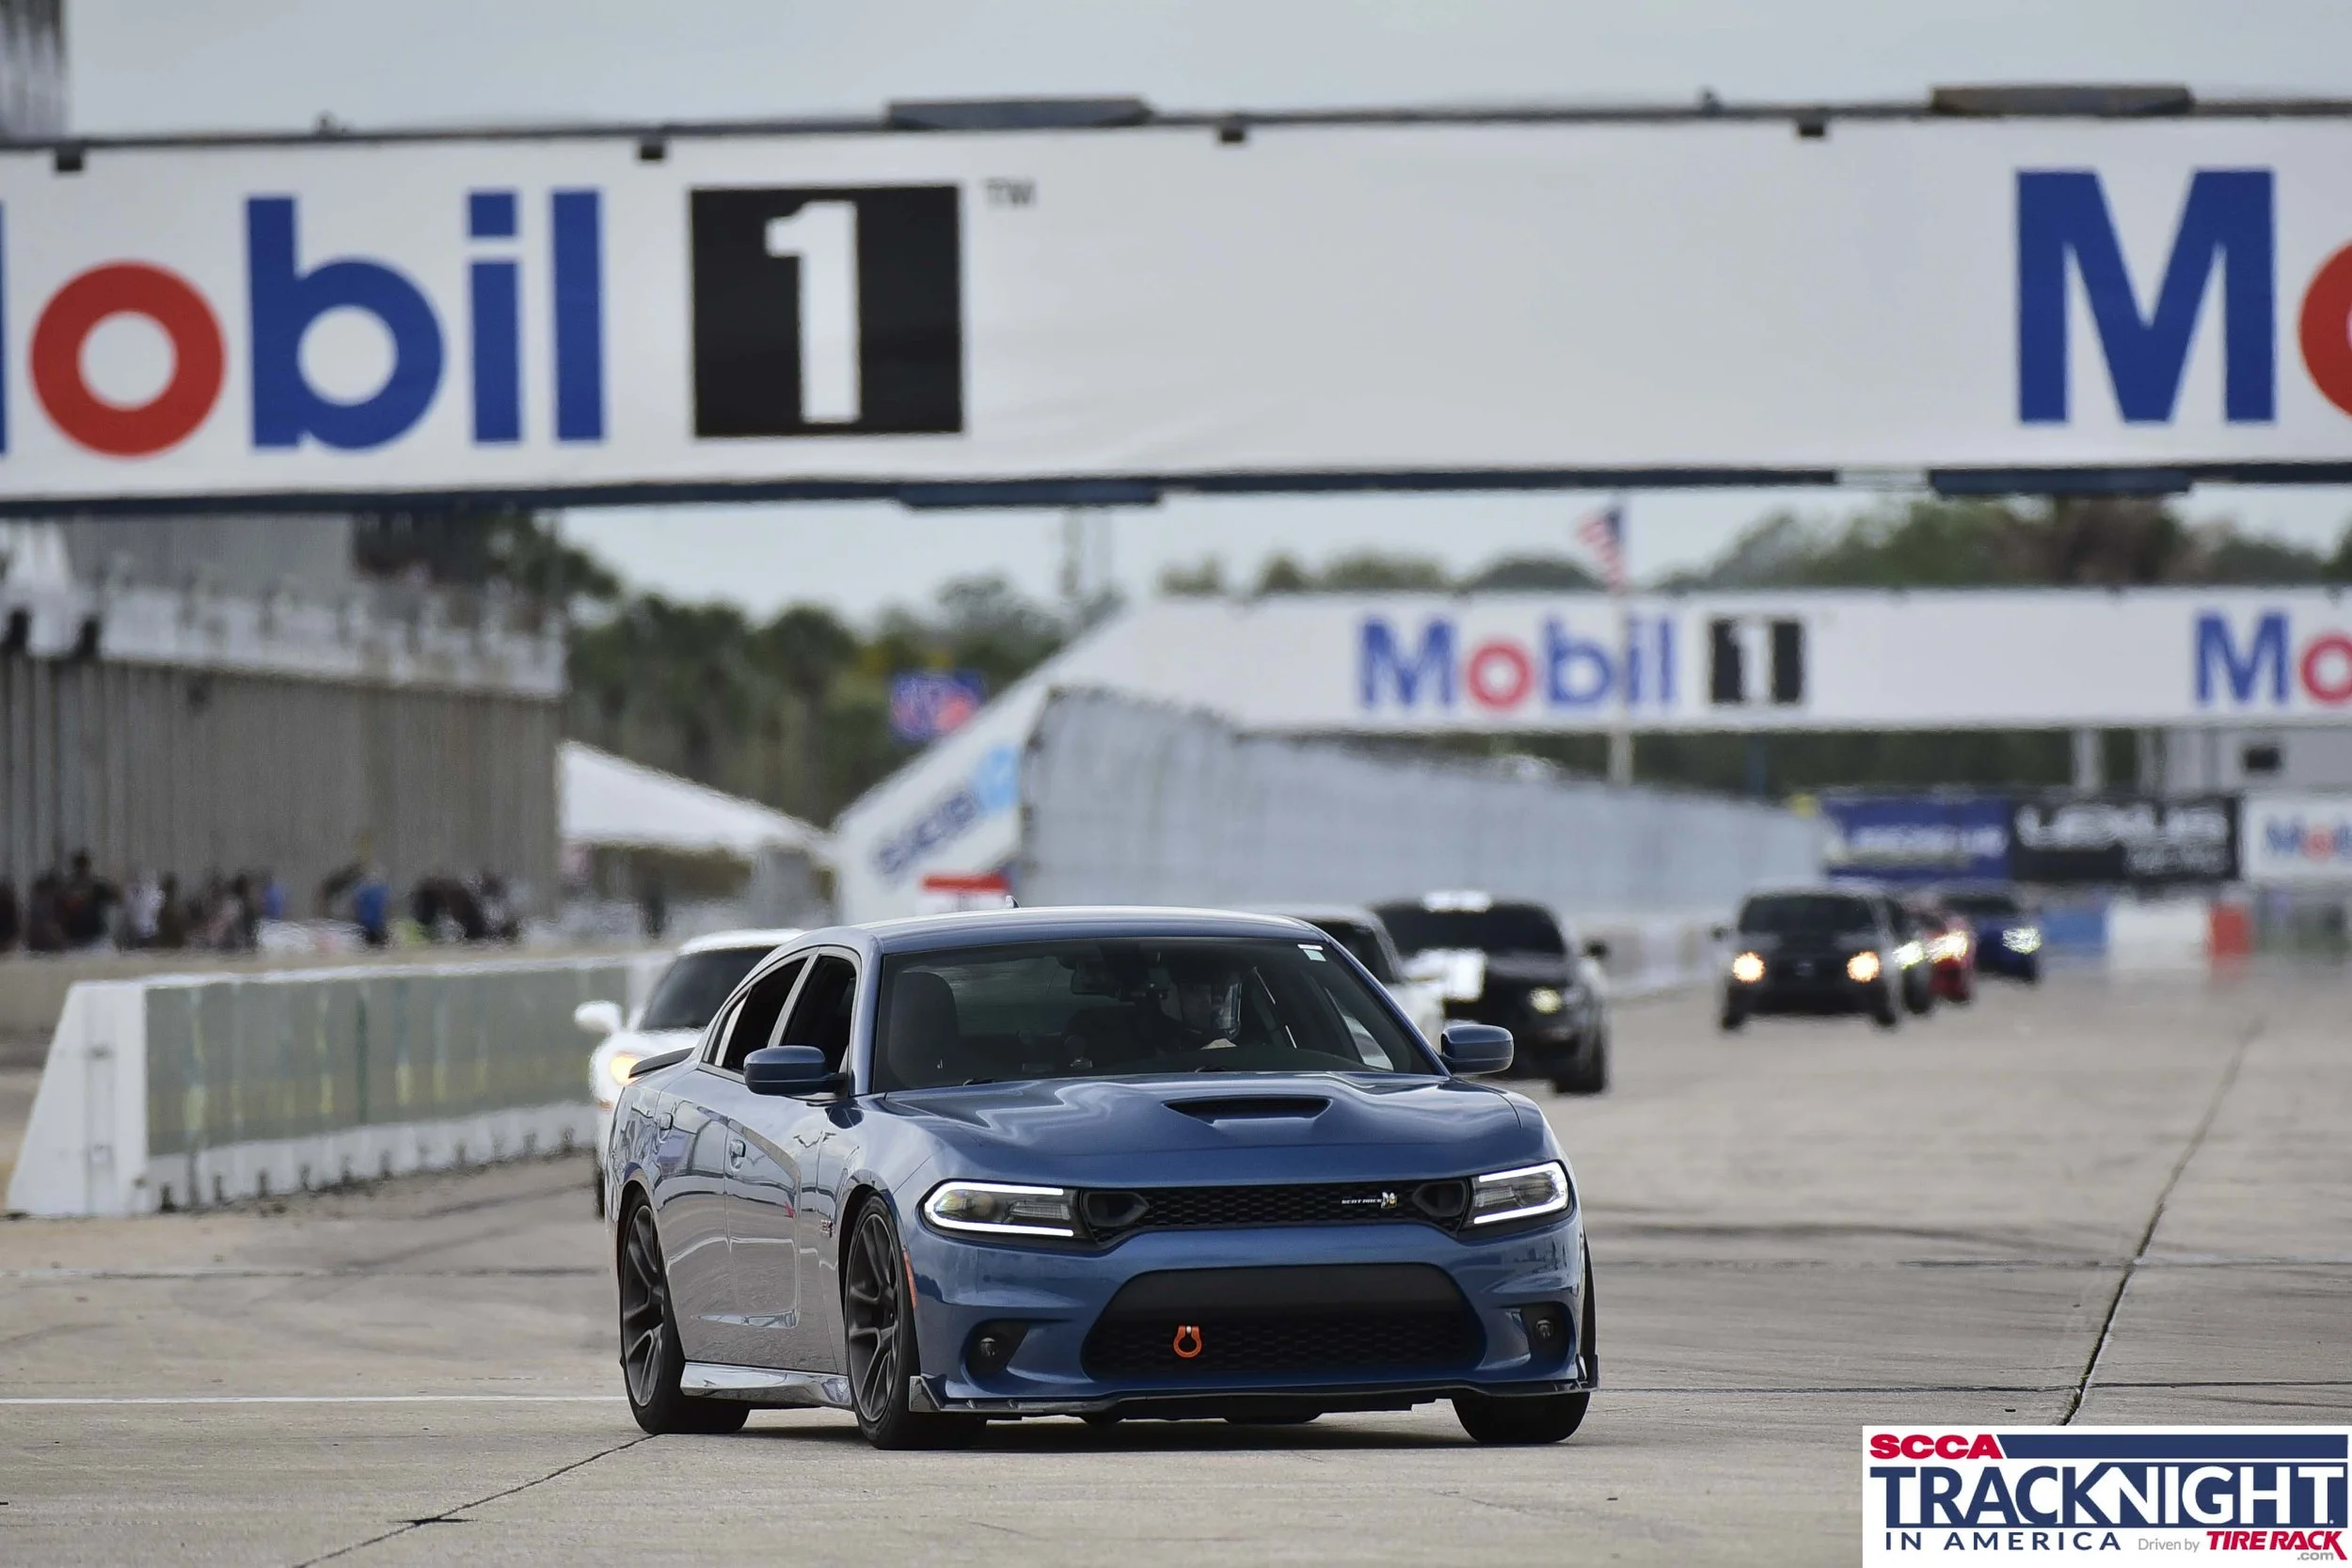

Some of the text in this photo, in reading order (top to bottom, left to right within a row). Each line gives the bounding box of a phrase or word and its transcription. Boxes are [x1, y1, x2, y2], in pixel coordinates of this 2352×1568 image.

[0, 191, 604, 457] obil
[765, 198, 863, 425] 1
[2016, 168, 2352, 425] M
[1361, 617, 1675, 707] Mobil
